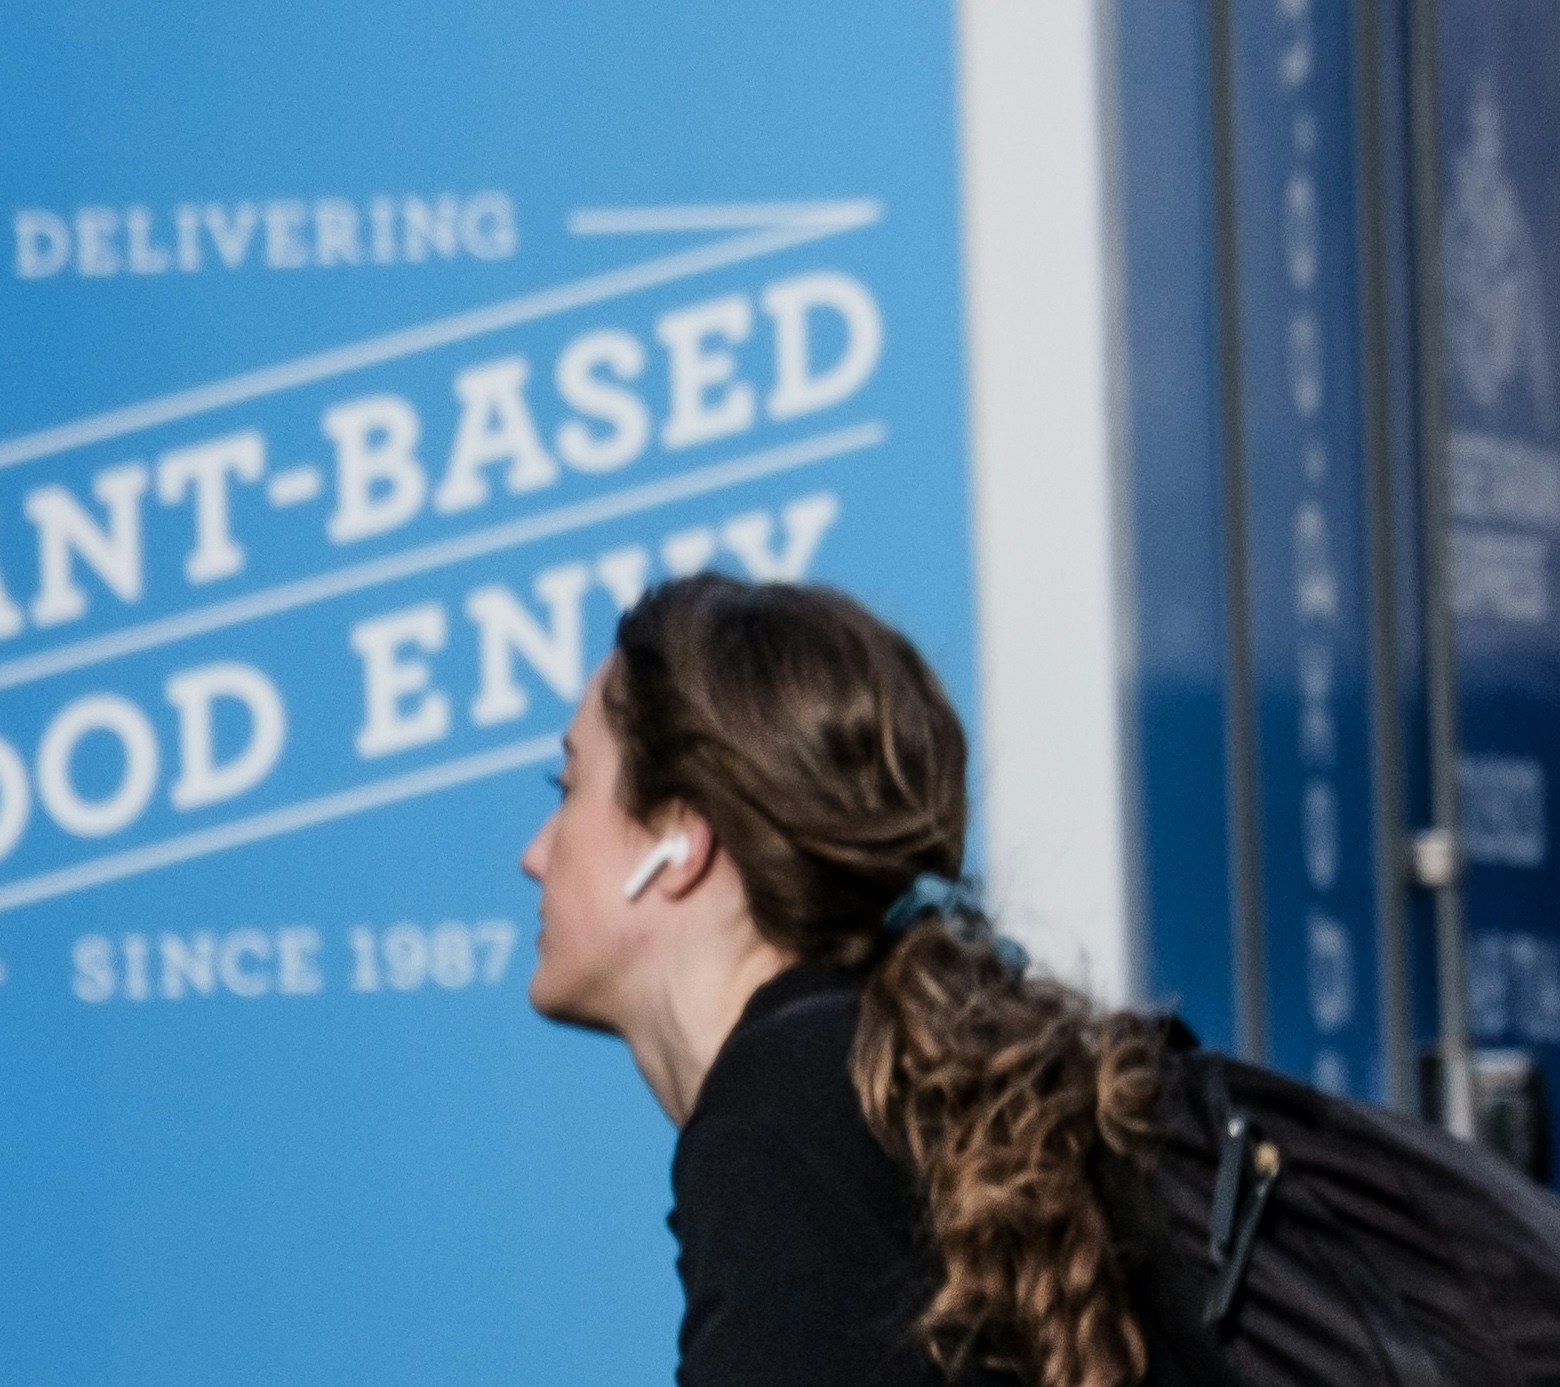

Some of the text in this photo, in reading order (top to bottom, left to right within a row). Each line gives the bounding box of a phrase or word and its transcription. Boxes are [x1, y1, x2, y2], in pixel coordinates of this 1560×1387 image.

[13, 191, 519, 279] DELIVERING
[72, 919, 518, 1002] SINCE 1987
